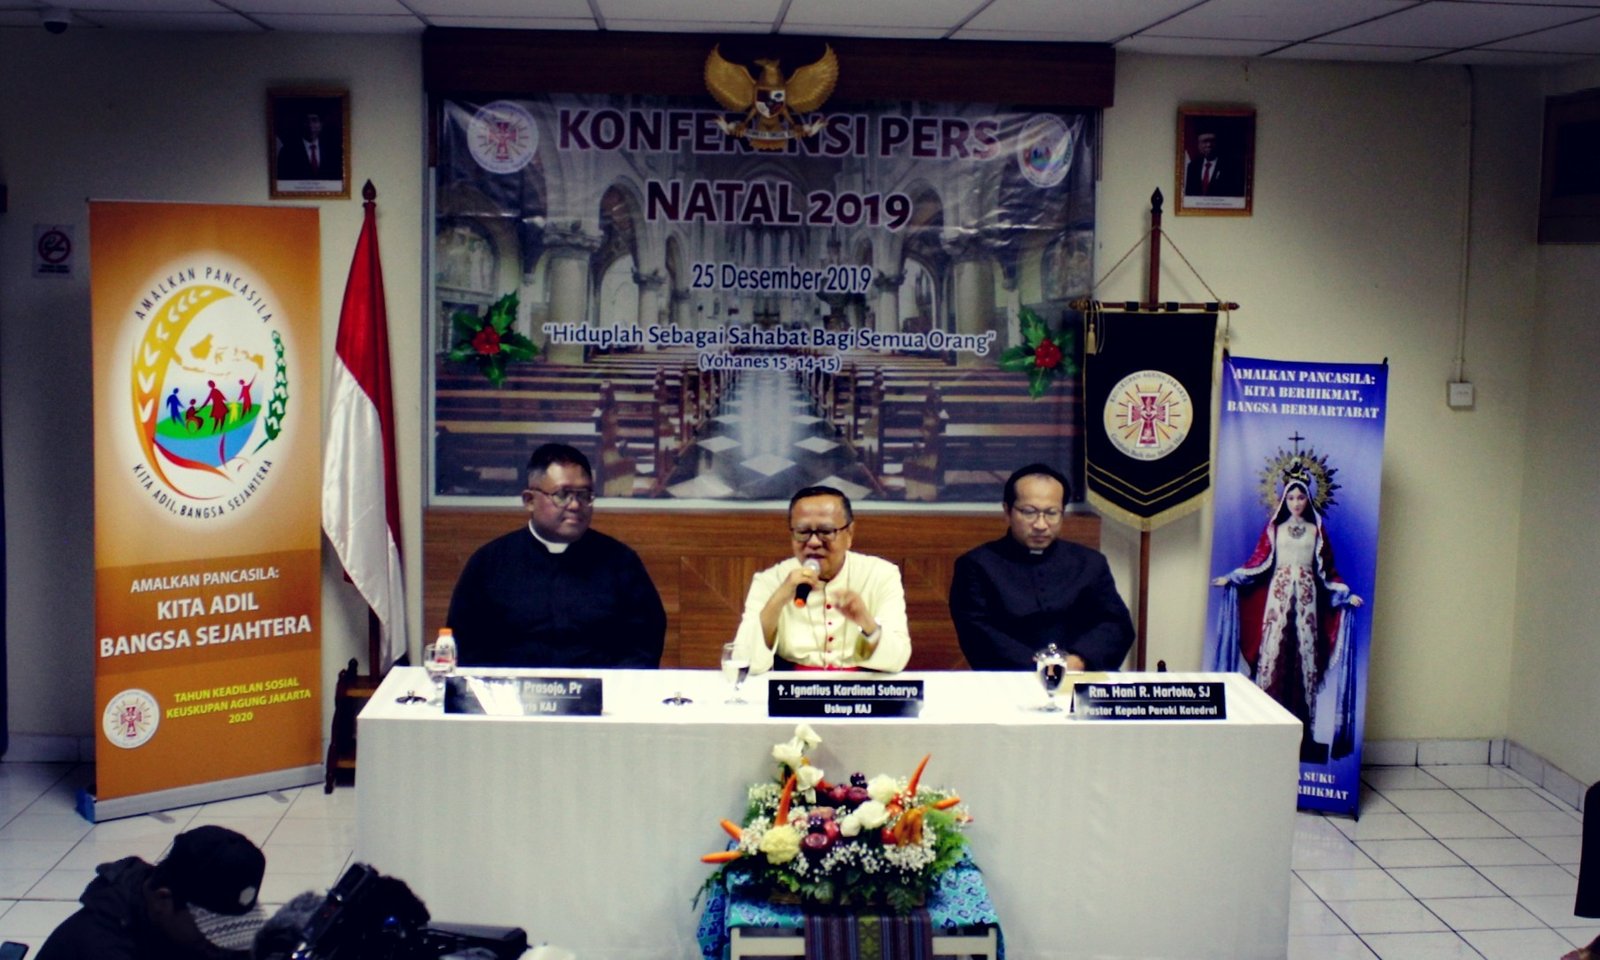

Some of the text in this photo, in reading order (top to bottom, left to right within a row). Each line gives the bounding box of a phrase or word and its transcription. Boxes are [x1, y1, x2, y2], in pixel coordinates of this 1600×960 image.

[559, 108, 867, 155] KONFERNSI
[880, 116, 999, 158] PERS
[646, 181, 911, 230] NATAL 2019
[692, 263, 872, 291] 25 Desember 2019
[134, 266, 273, 323] AMALKAN PANCASILA
[648, 325, 724, 347] Sebagai
[728, 327, 808, 345] Sahabat
[813, 328, 854, 350] Bagi
[859, 329, 924, 348] Semua
[699, 352, 768, 370] (Yohanes
[1233, 368, 1376, 385] AMALKAN PANCASILA:
[1244, 385, 1363, 402] KITA BERHIKMAT,
[1227, 400, 1379, 419] BANGSA BERMARTABAT
[133, 459, 272, 519] KITA ADIL, BANGSA SEJAHTERA
[130, 566, 280, 593] AMALKAN PANCASILA:
[157, 592, 259, 620] KITA ADIL
[100, 614, 312, 658] BANGSA SEJAHTERA
[174, 677, 299, 703] TAHUN KEADILAN SOSIAL
[523, 681, 566, 696] Prasojo,
[569, 681, 583, 694] Pr
[791, 684, 831, 698] Ignatius
[833, 684, 875, 696] Kardinal
[878, 684, 918, 698] Suharyo
[1089, 685, 1210, 699] Rm. Hani R. Hartoko, SJ
[166, 689, 311, 719] KEUSKUPAN AGUNG JAKARTA
[540, 702, 557, 711] KAJ
[824, 703, 872, 715] Uskup KAJ
[1115, 706, 1146, 717] Kepala
[1148, 705, 1177, 716] Paroki
[1179, 705, 1217, 716] Katedral
[228, 711, 253, 724] 2020
[1304, 771, 1335, 784] SUKU
[1298, 785, 1349, 800] HIKMAT
